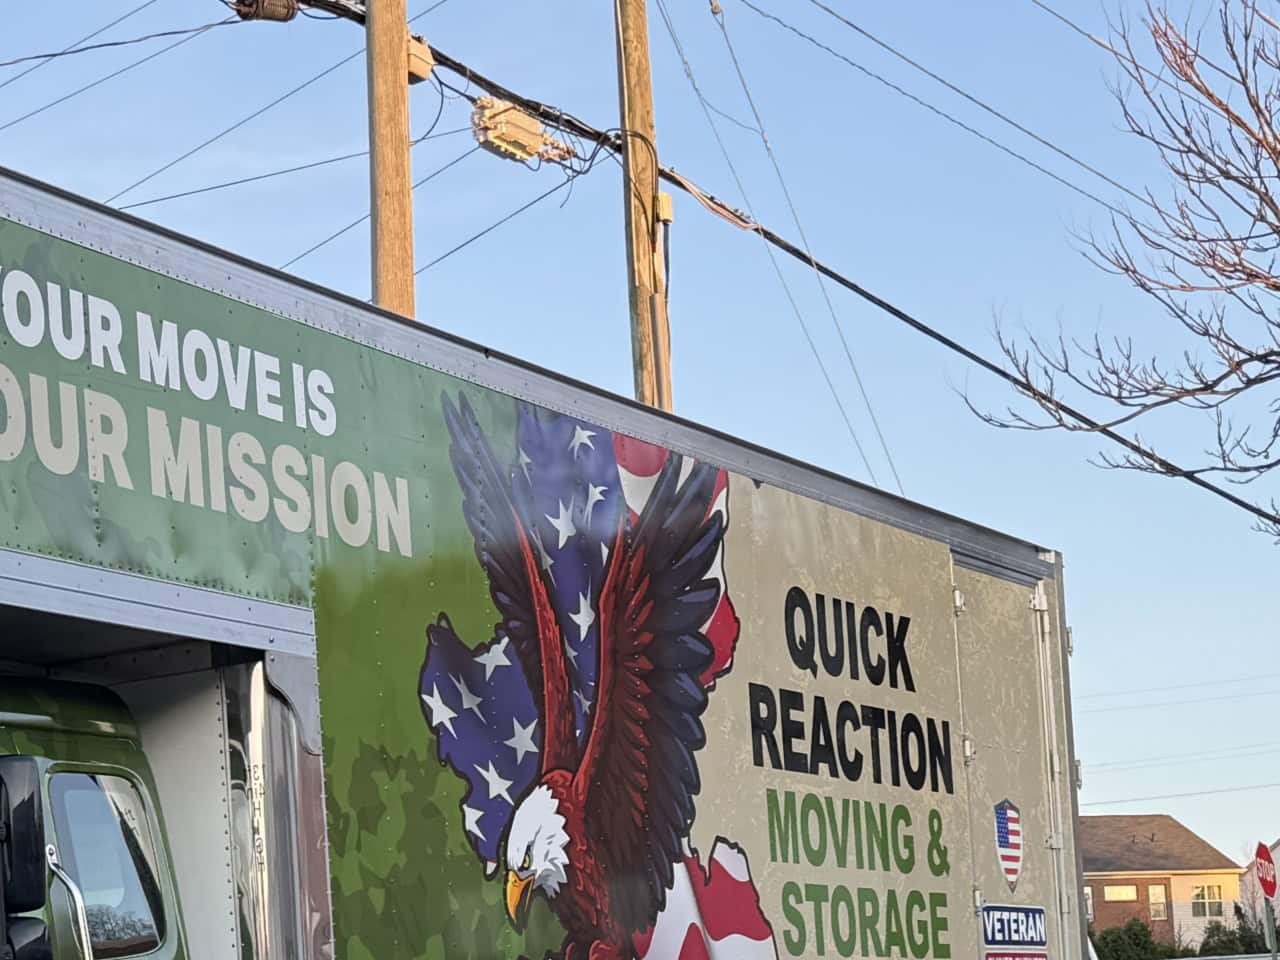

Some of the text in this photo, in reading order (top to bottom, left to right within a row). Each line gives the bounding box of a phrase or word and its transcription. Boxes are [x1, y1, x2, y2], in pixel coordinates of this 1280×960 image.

[136, 311, 285, 423] MOVE
[292, 363, 337, 436] IS
[146, 406, 414, 559] MISSION
[784, 585, 917, 694] QUICK
[748, 682, 955, 795] REACTION
[766, 787, 951, 878] MOVING &
[781, 880, 952, 960] STORAGE
[983, 911, 1047, 942] VETERAN
